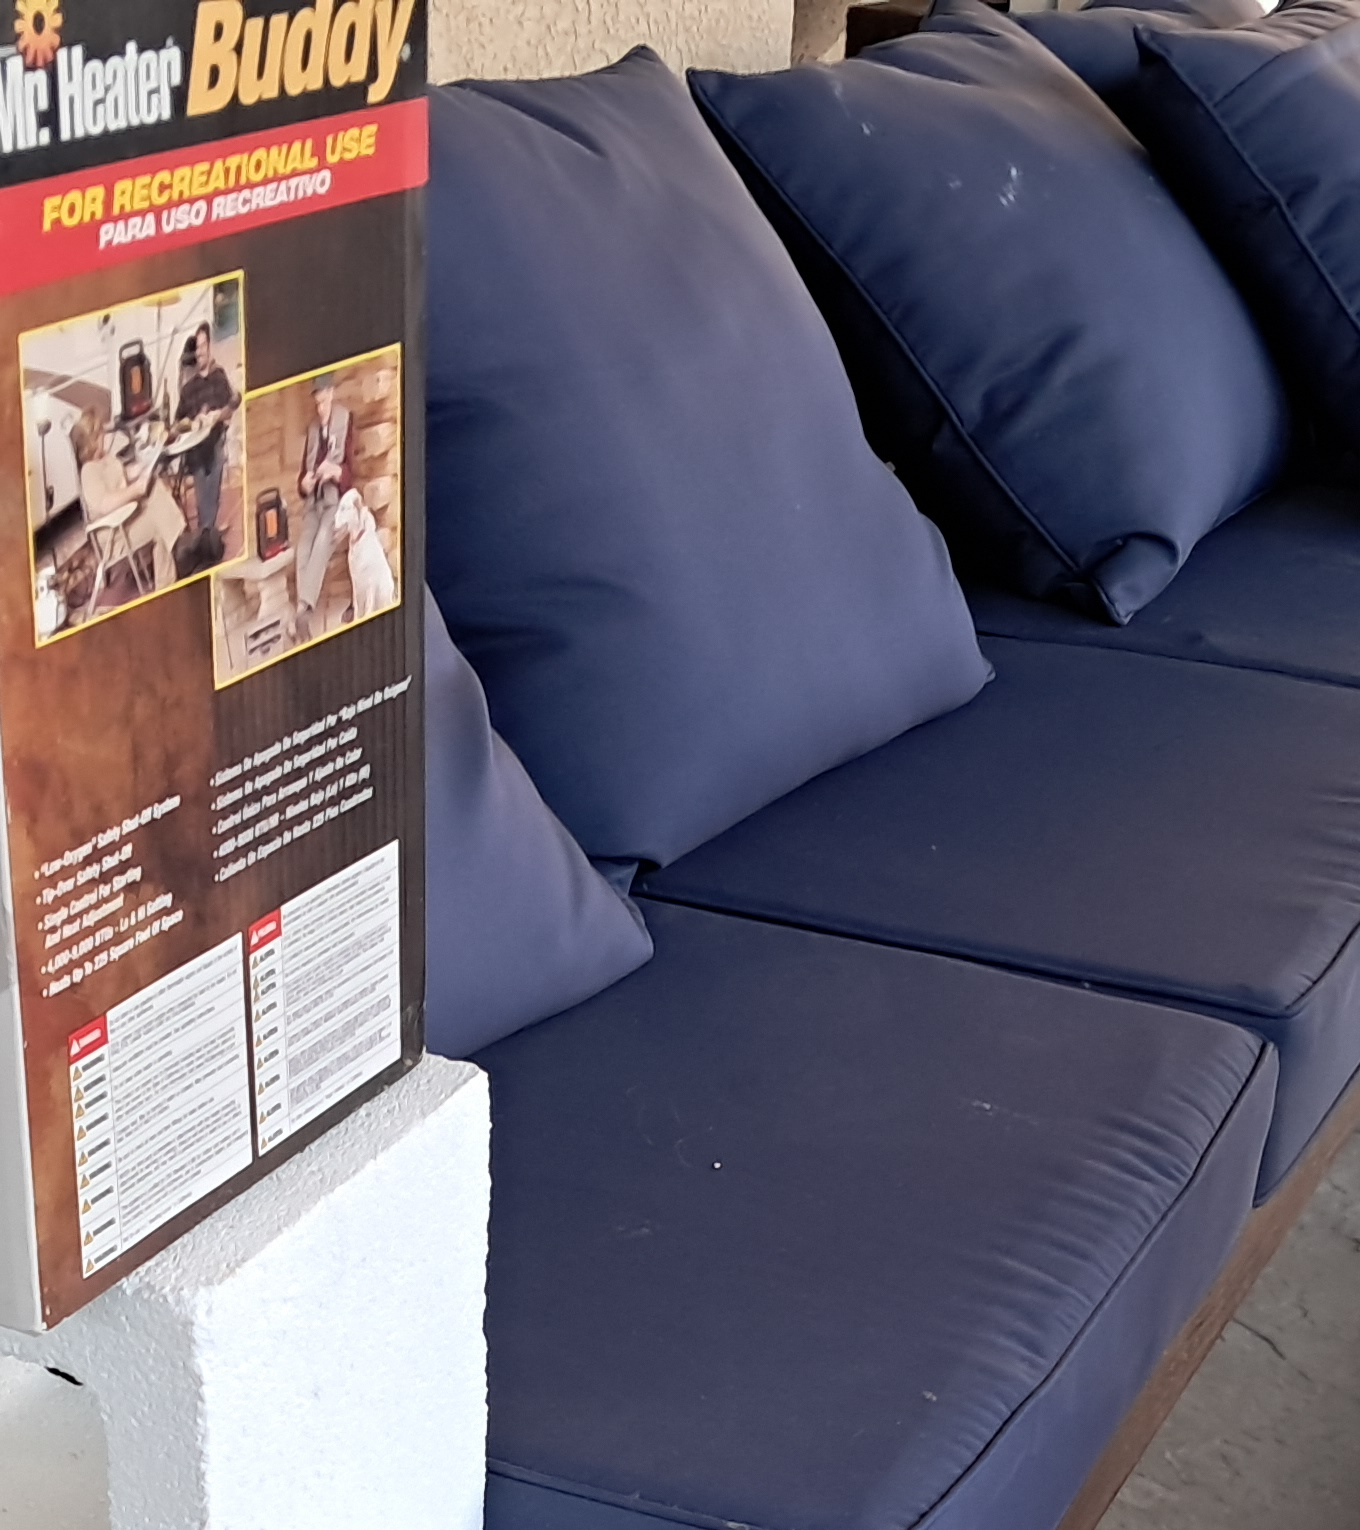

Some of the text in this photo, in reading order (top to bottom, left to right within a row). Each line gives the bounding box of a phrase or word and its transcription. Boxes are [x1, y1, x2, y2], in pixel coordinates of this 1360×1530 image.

[57, 40, 181, 141] Heater
[186, 0, 415, 116] Buddy
[43, 123, 378, 232] FOR RECREATIONAL USE
[99, 169, 332, 250] PARA USO RECREATIVO
